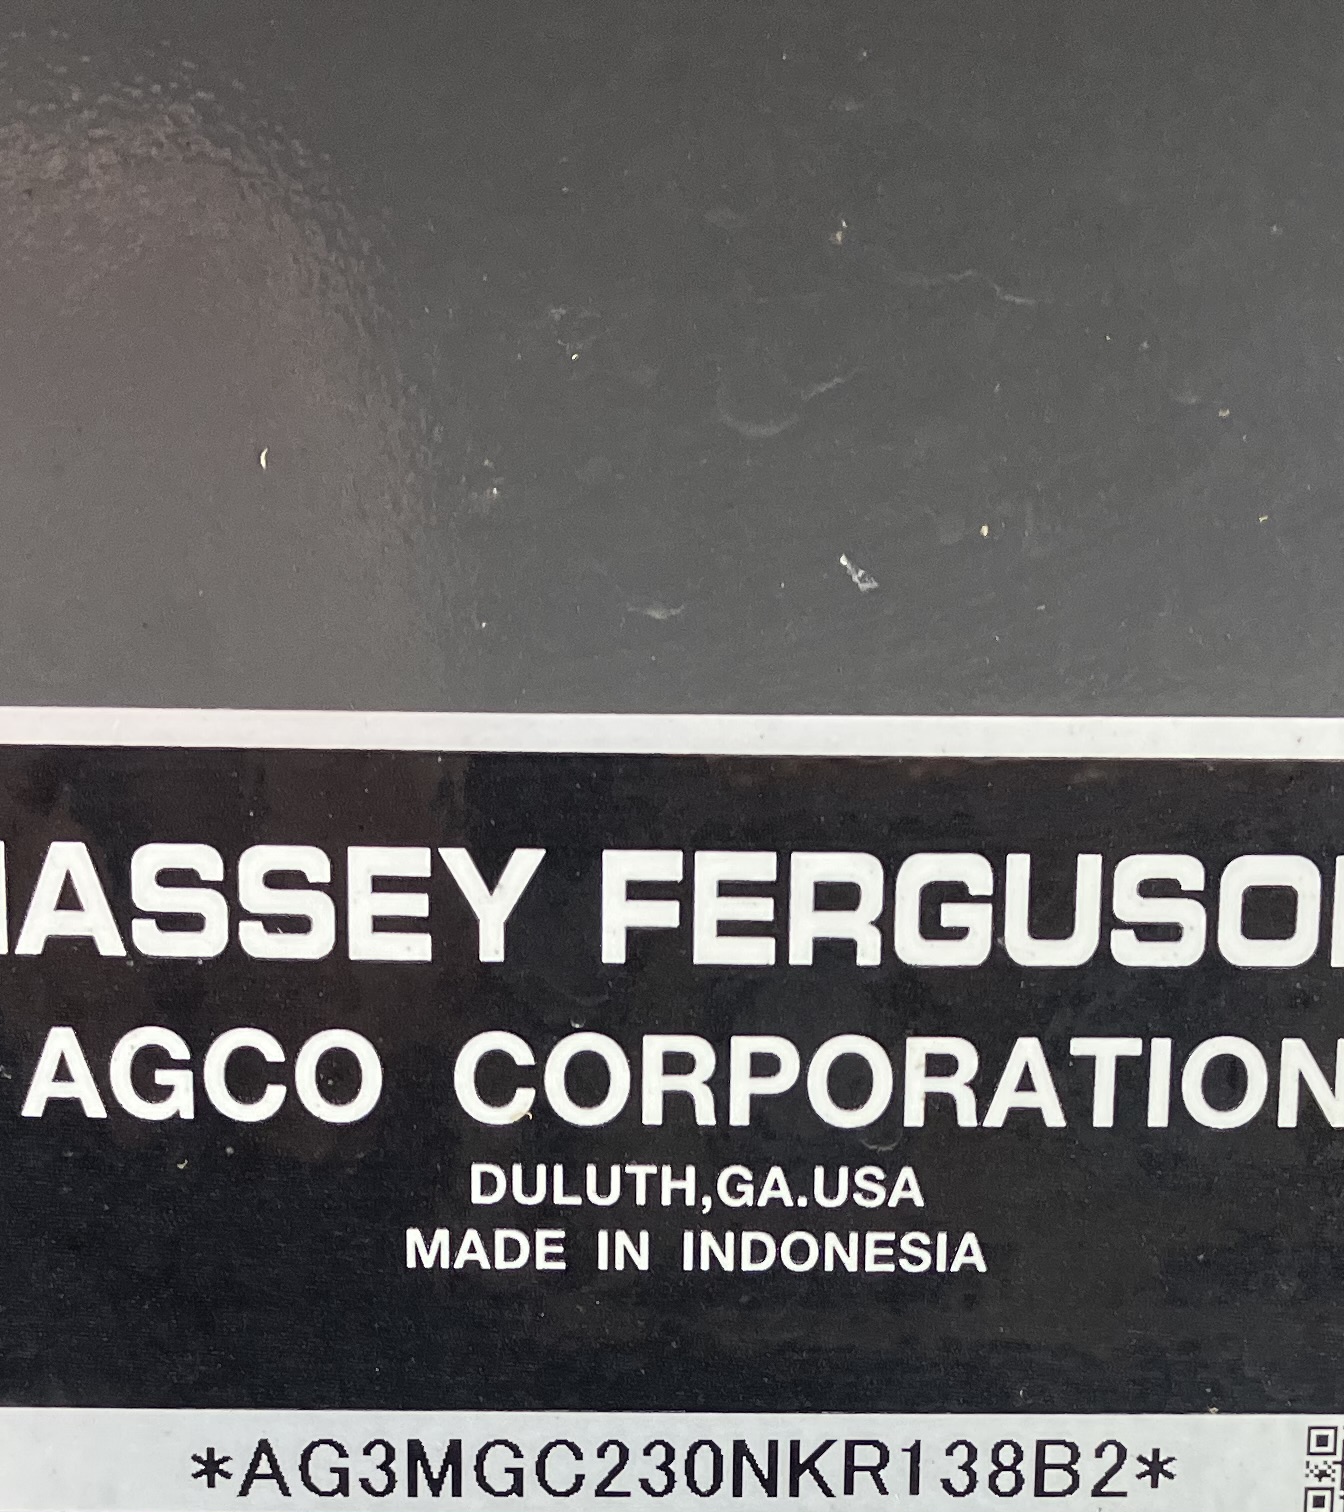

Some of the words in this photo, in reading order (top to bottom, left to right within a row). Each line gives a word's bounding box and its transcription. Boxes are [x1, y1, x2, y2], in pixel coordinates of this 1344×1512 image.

[20, 1025, 383, 1124] AGCO
[470, 1162, 925, 1215] DULUTH,GA.USA
[406, 1227, 567, 1270] MADE
[597, 1229, 649, 1271] IN
[683, 1230, 987, 1273] INDONESIA
